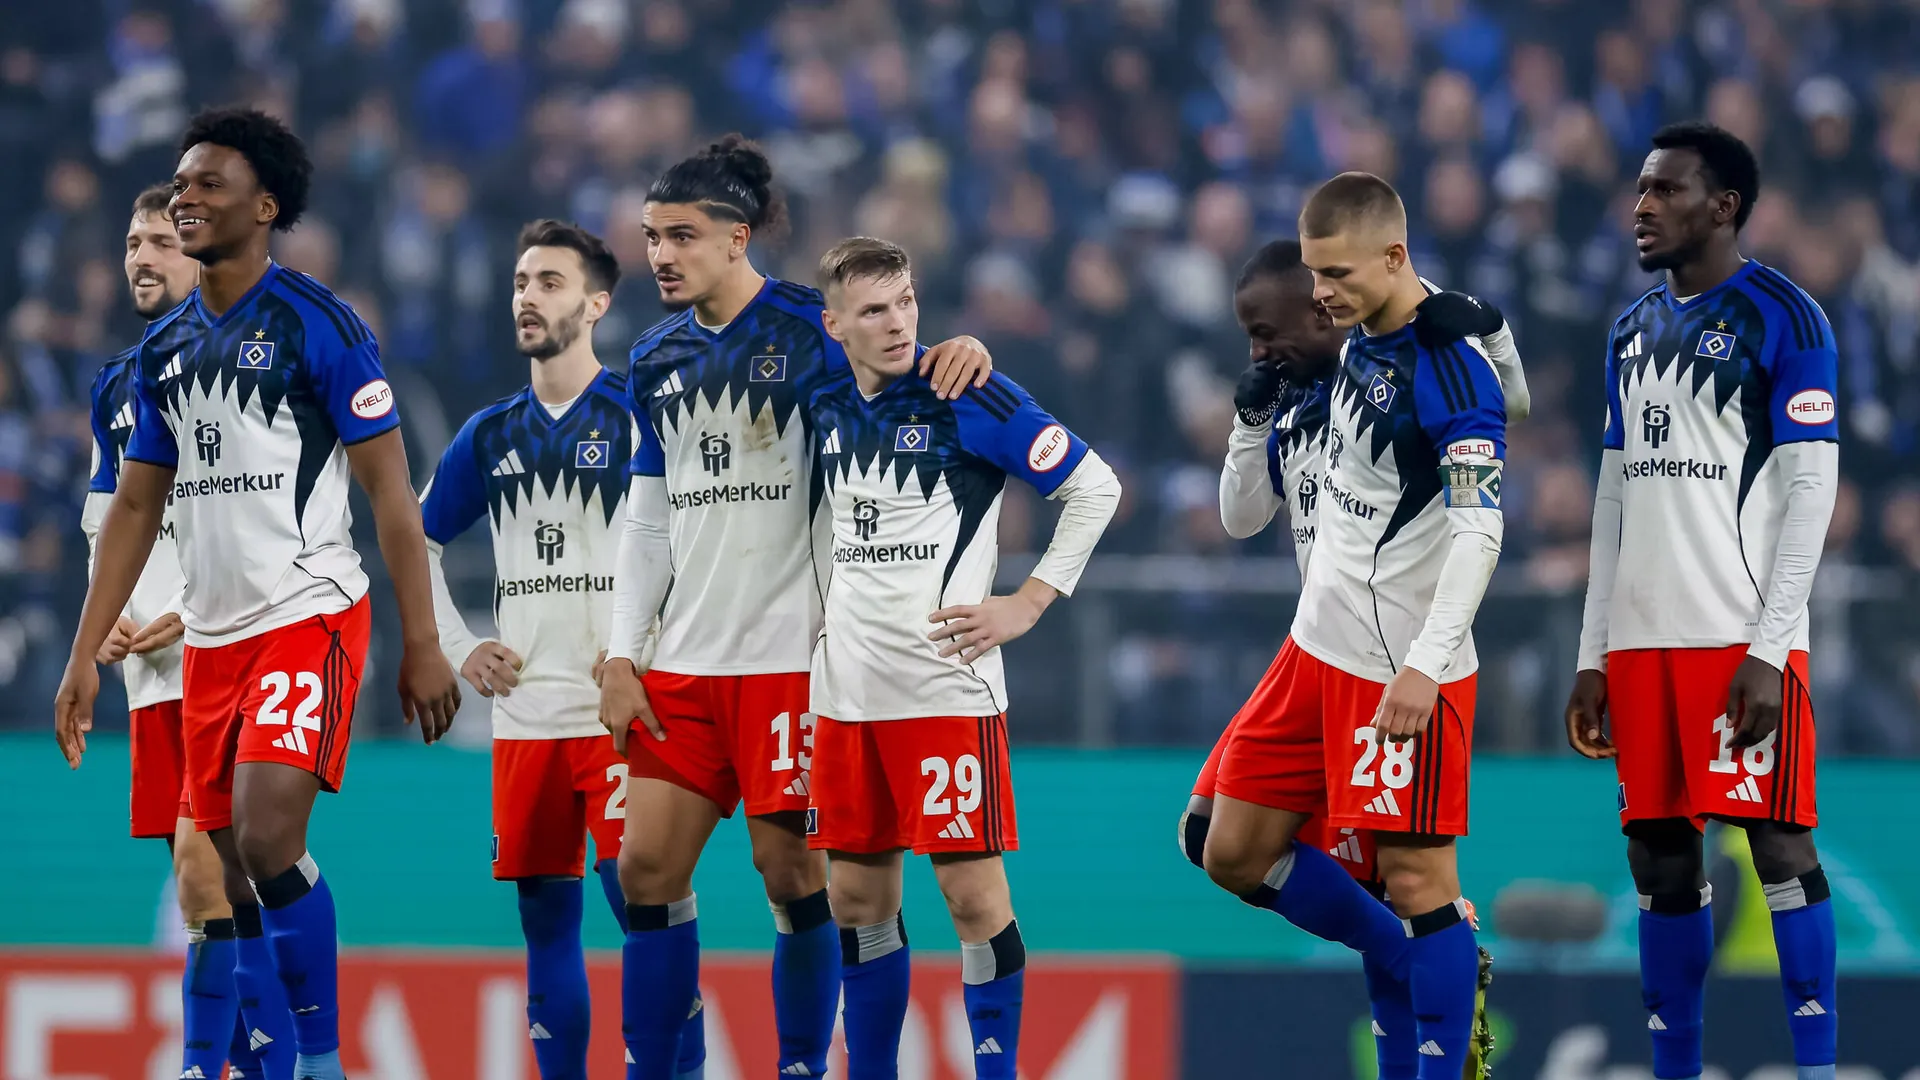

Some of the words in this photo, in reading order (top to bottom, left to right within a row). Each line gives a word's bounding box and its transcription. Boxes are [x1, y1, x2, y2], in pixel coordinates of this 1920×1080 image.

[355, 387, 391, 411] HELM
[1791, 401, 1833, 413] HELM
[1033, 429, 1064, 467] HELM
[176, 472, 285, 499] anseMerkur
[255, 670, 323, 733] 22
[770, 711, 819, 772] 13
[1350, 725, 1415, 790] 28
[920, 753, 982, 816] 29
